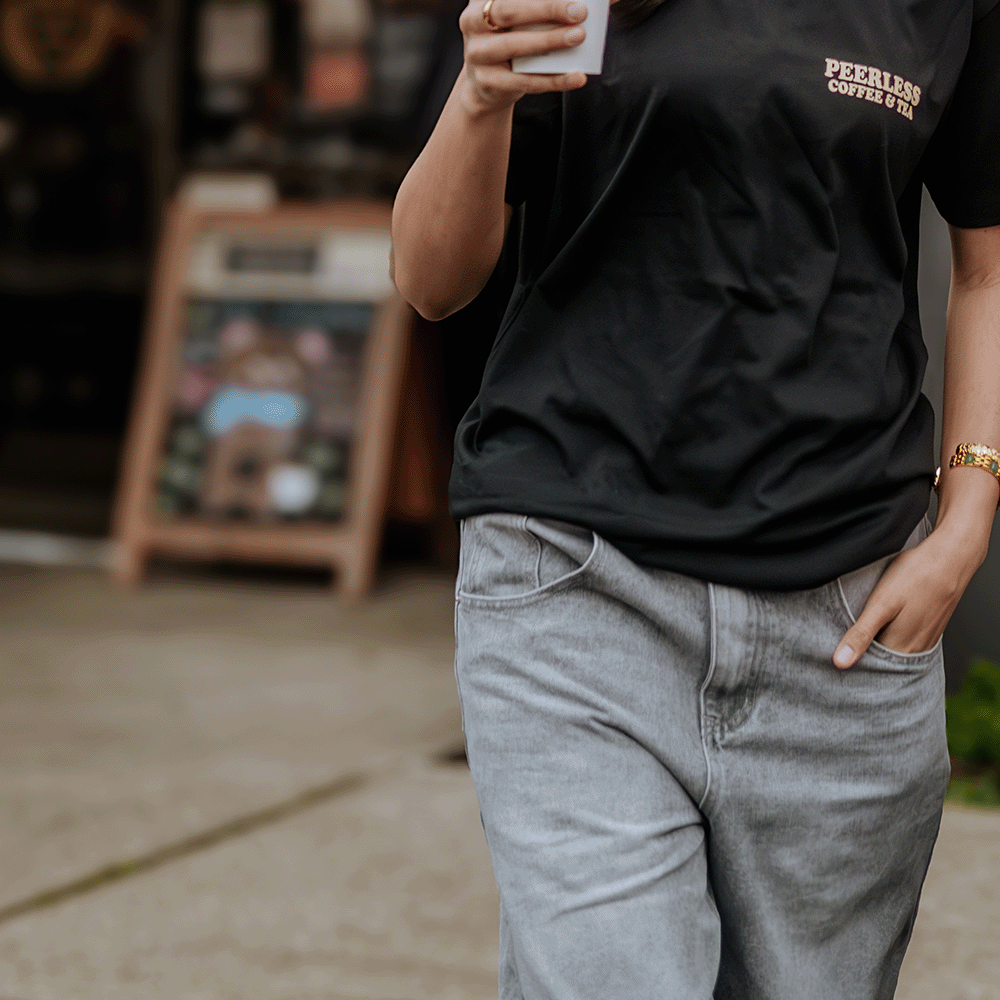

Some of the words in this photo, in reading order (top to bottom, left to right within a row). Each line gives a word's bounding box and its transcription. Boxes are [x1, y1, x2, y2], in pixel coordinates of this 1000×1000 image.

[824, 57, 922, 107] PEERLESS
[827, 78, 884, 105] COFFEE
[884, 93, 896, 109] &
[896, 98, 914, 121] TEA
